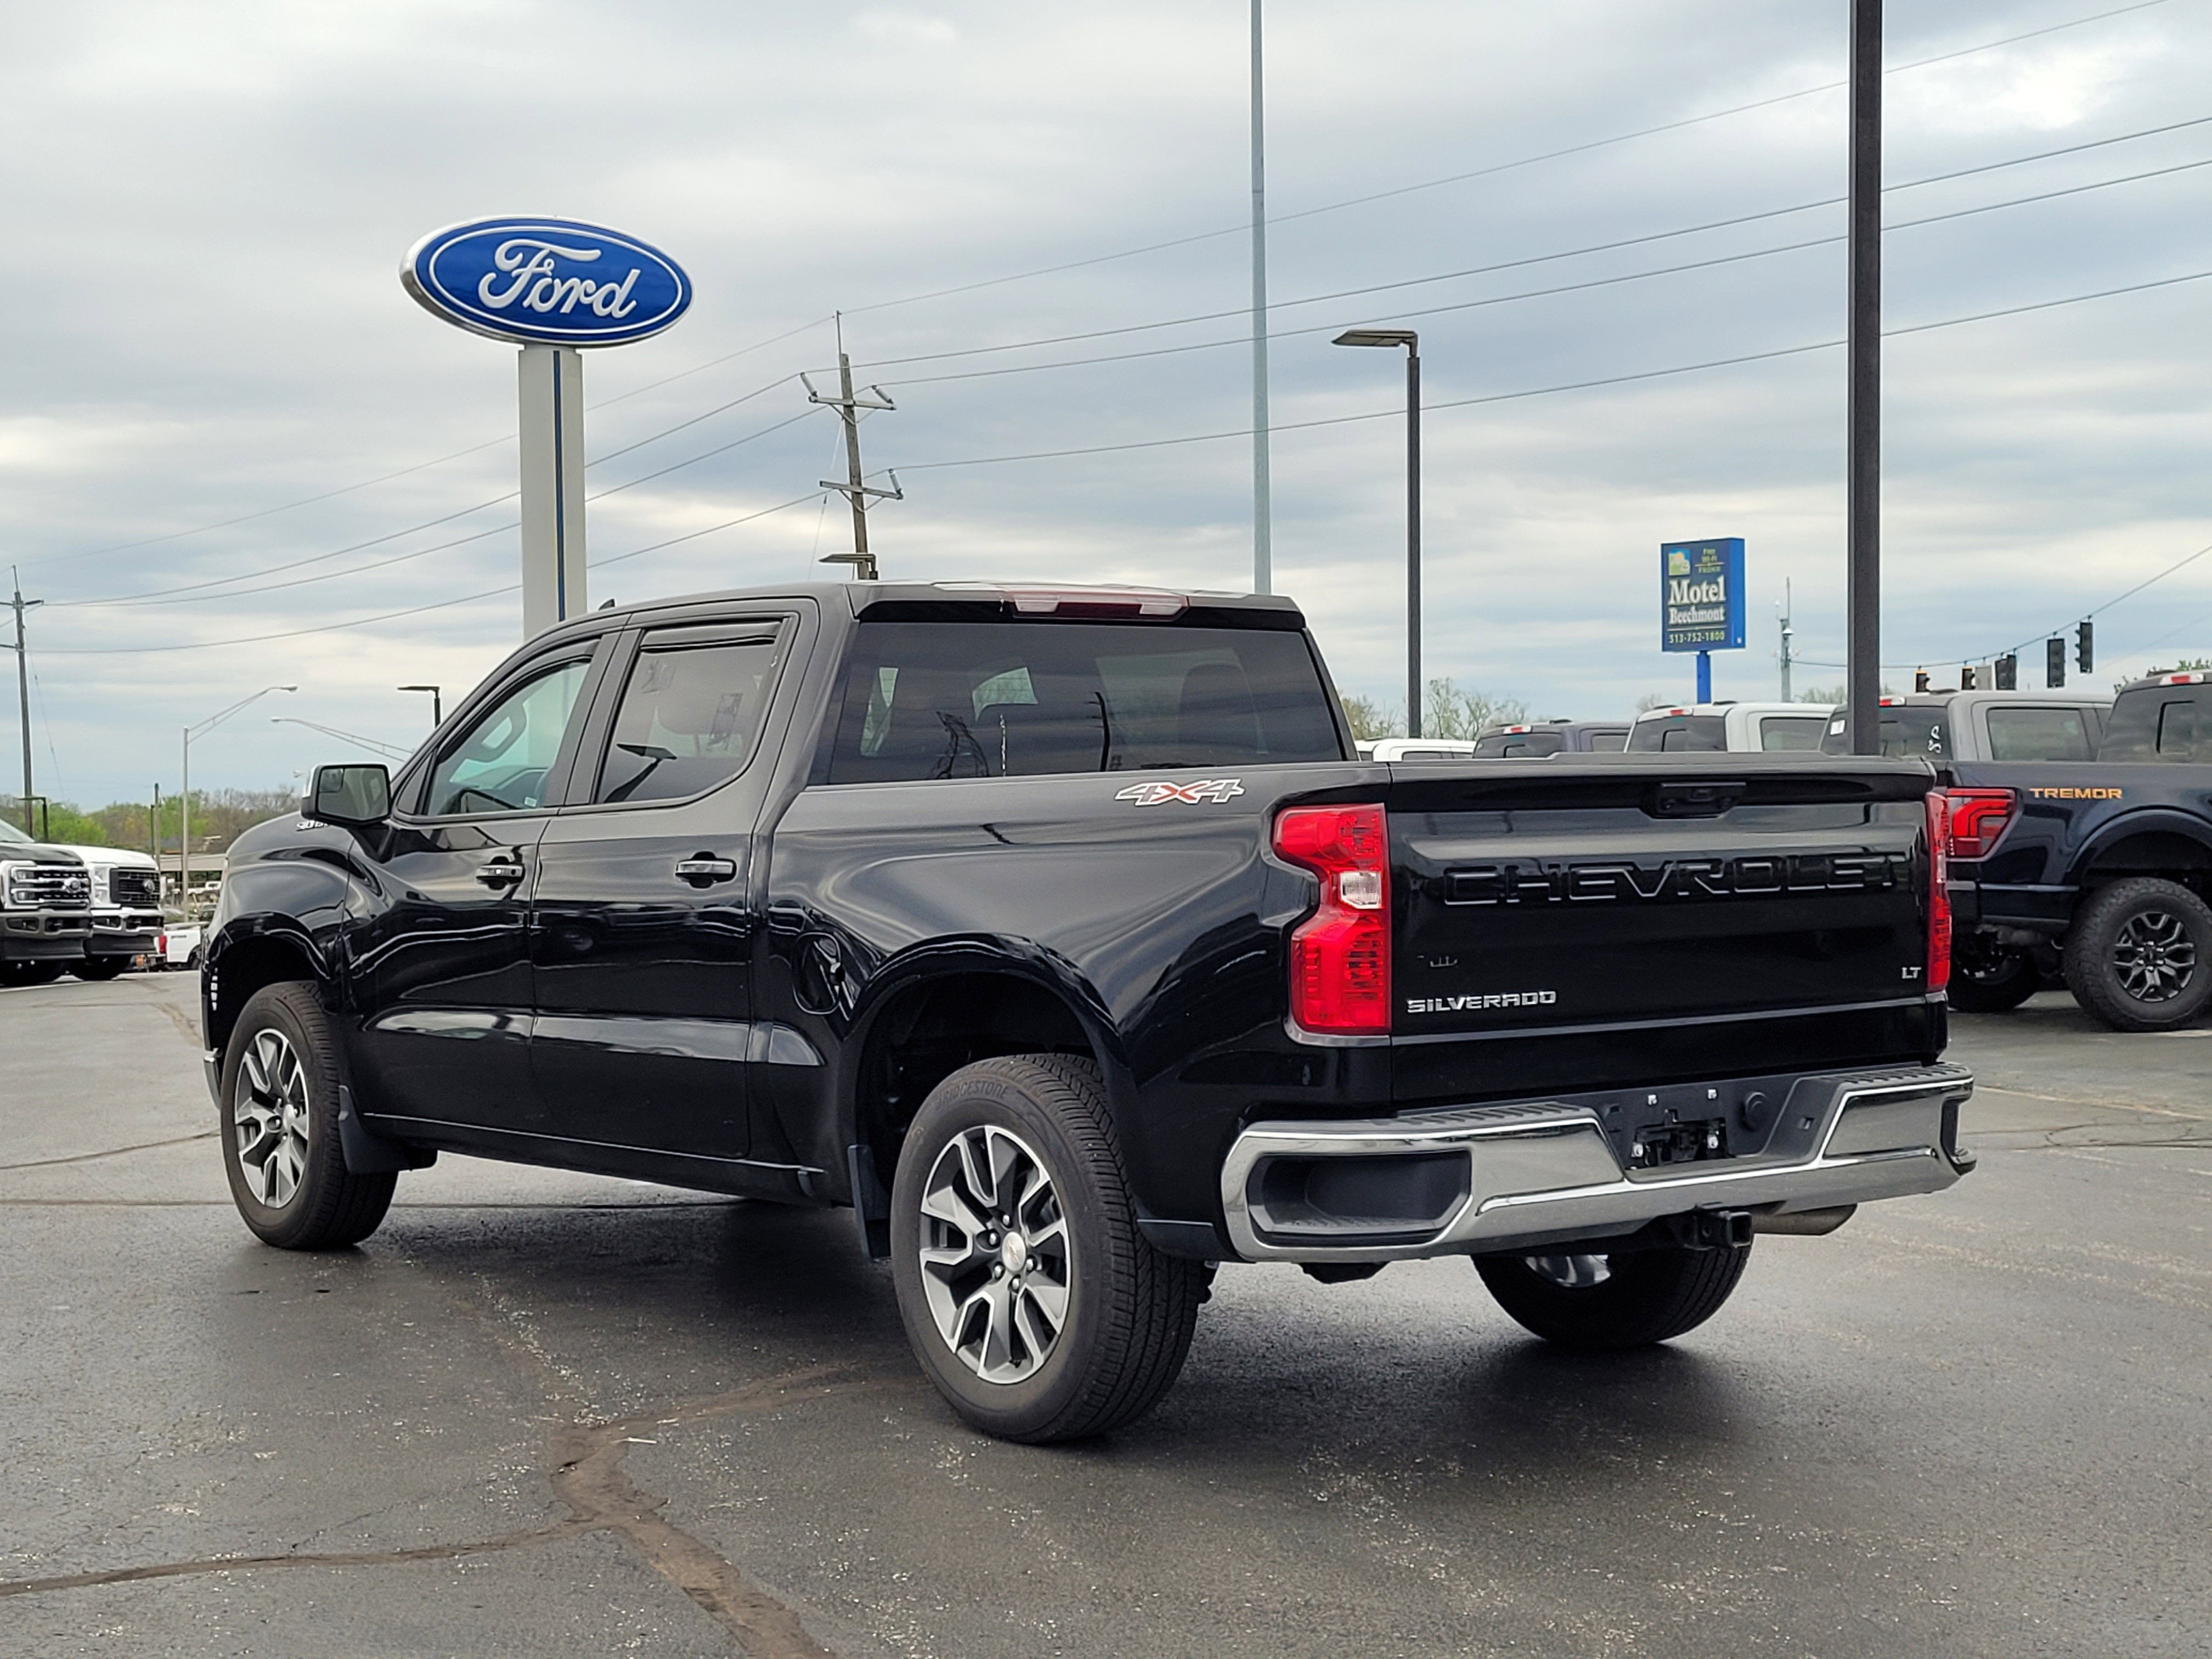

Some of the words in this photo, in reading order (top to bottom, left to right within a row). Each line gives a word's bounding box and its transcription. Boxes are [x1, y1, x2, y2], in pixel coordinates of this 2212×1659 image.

[478, 239, 641, 318] Ford
[1668, 574, 1726, 605] Motel
[2028, 787, 2123, 799] TREMOR
[1443, 852, 1906, 905] CHEVROLET
[1901, 966, 1922, 979] LT
[1407, 990, 1556, 1013] SILVERADO
